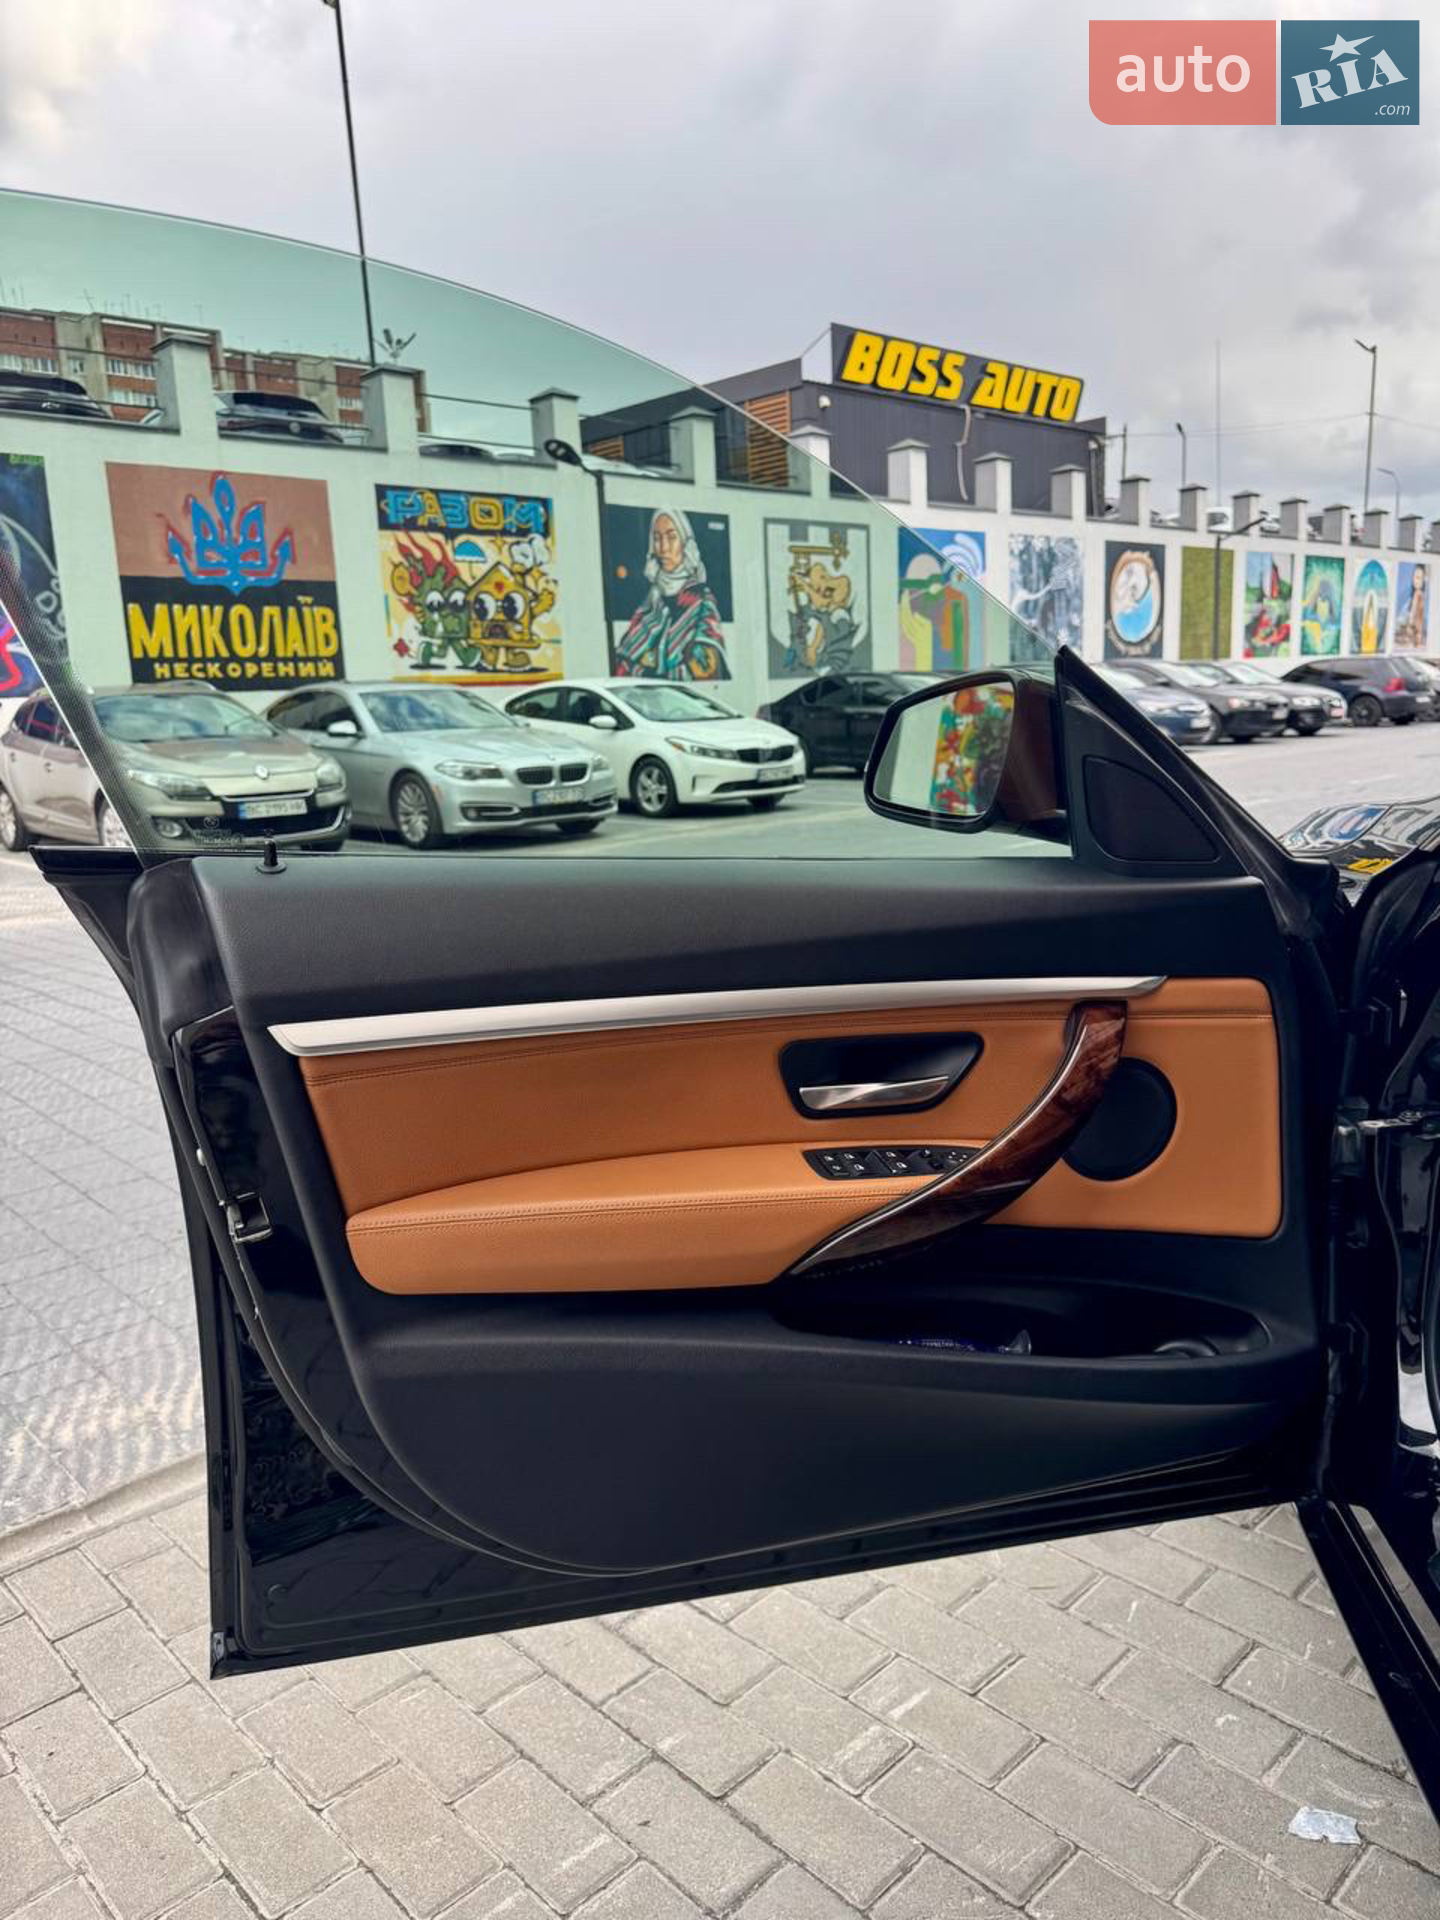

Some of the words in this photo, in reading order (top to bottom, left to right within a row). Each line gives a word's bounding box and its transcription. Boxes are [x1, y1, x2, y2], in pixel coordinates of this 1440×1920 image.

[840, 329, 967, 401] BOSS
[383, 489, 546, 534] РАЗОМ
[127, 595, 339, 659] МИКОЛАЇВ
[153, 659, 336, 679] НЕСКОРЕНИЙ
